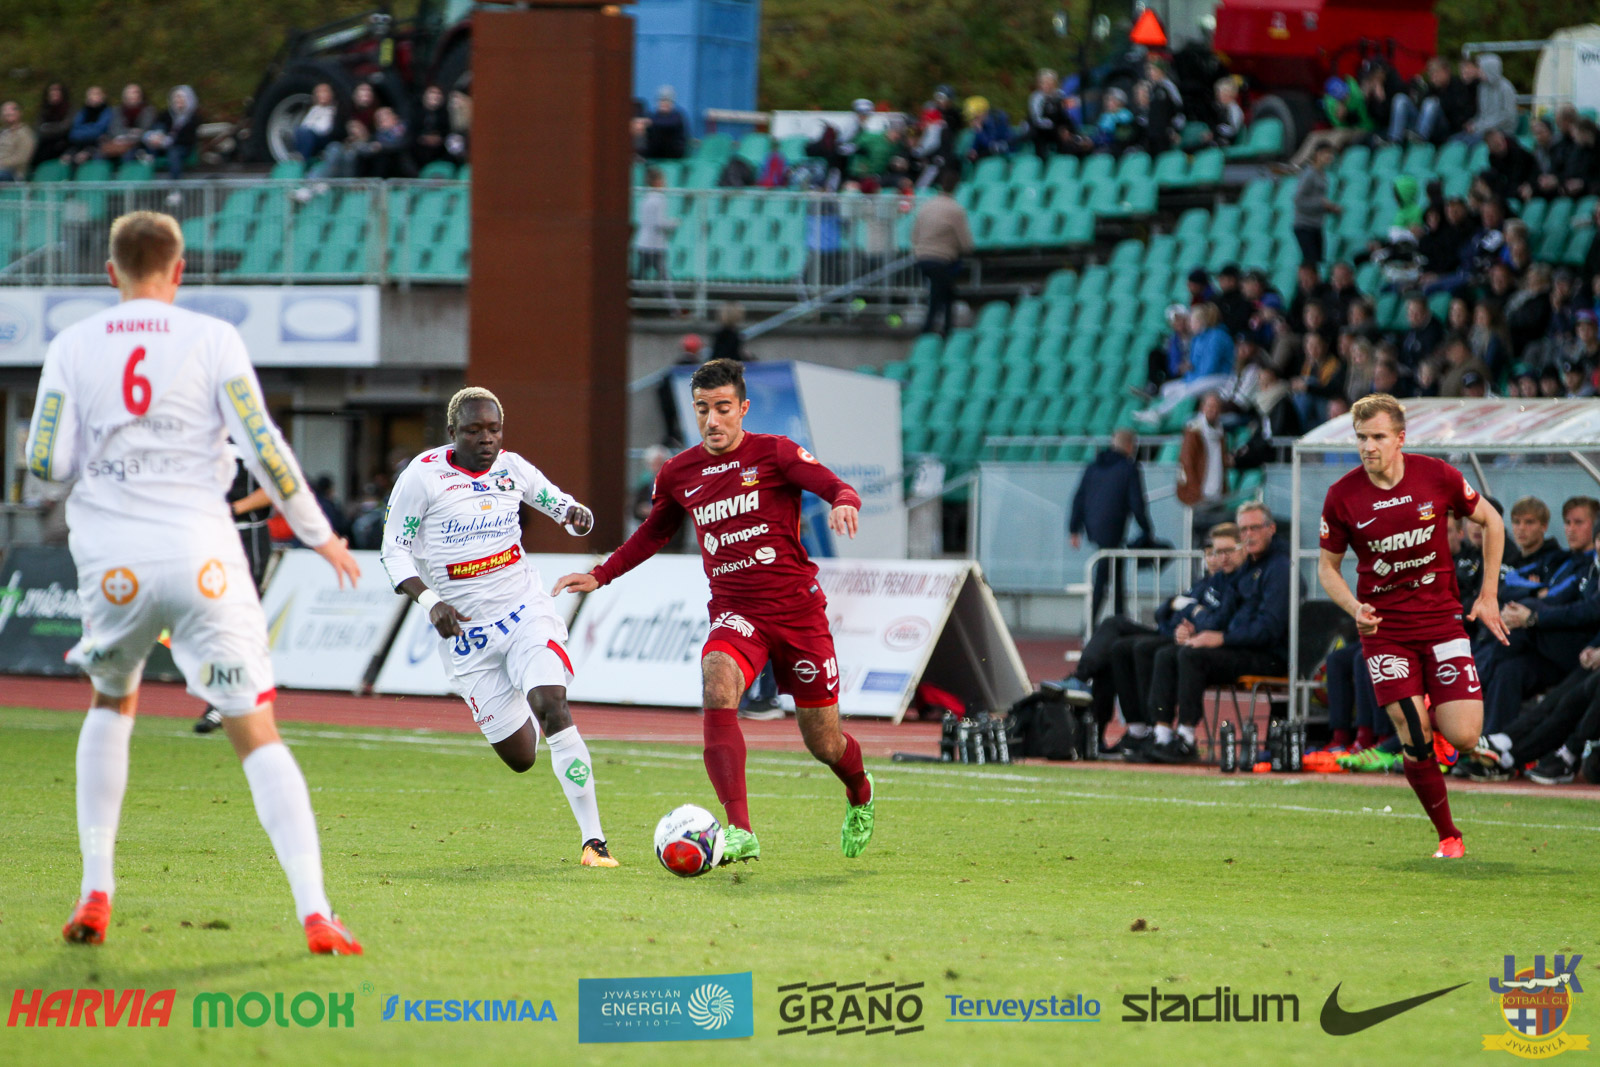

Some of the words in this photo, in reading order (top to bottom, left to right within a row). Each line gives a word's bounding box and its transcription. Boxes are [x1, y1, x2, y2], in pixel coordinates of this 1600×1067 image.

[106, 319, 171, 334] BRUNELL
[122, 345, 152, 416] 6
[702, 460, 740, 476] stadium
[693, 490, 759, 526] HARVIA
[1372, 495, 1413, 511] stadium
[1367, 524, 1436, 553] HARVIA
[452, 549, 512, 576] Halpa-Halli
[712, 556, 757, 578] JYVÄSKYLÄ
[205, 663, 243, 687] JNT
[823, 657, 838, 679] 18
